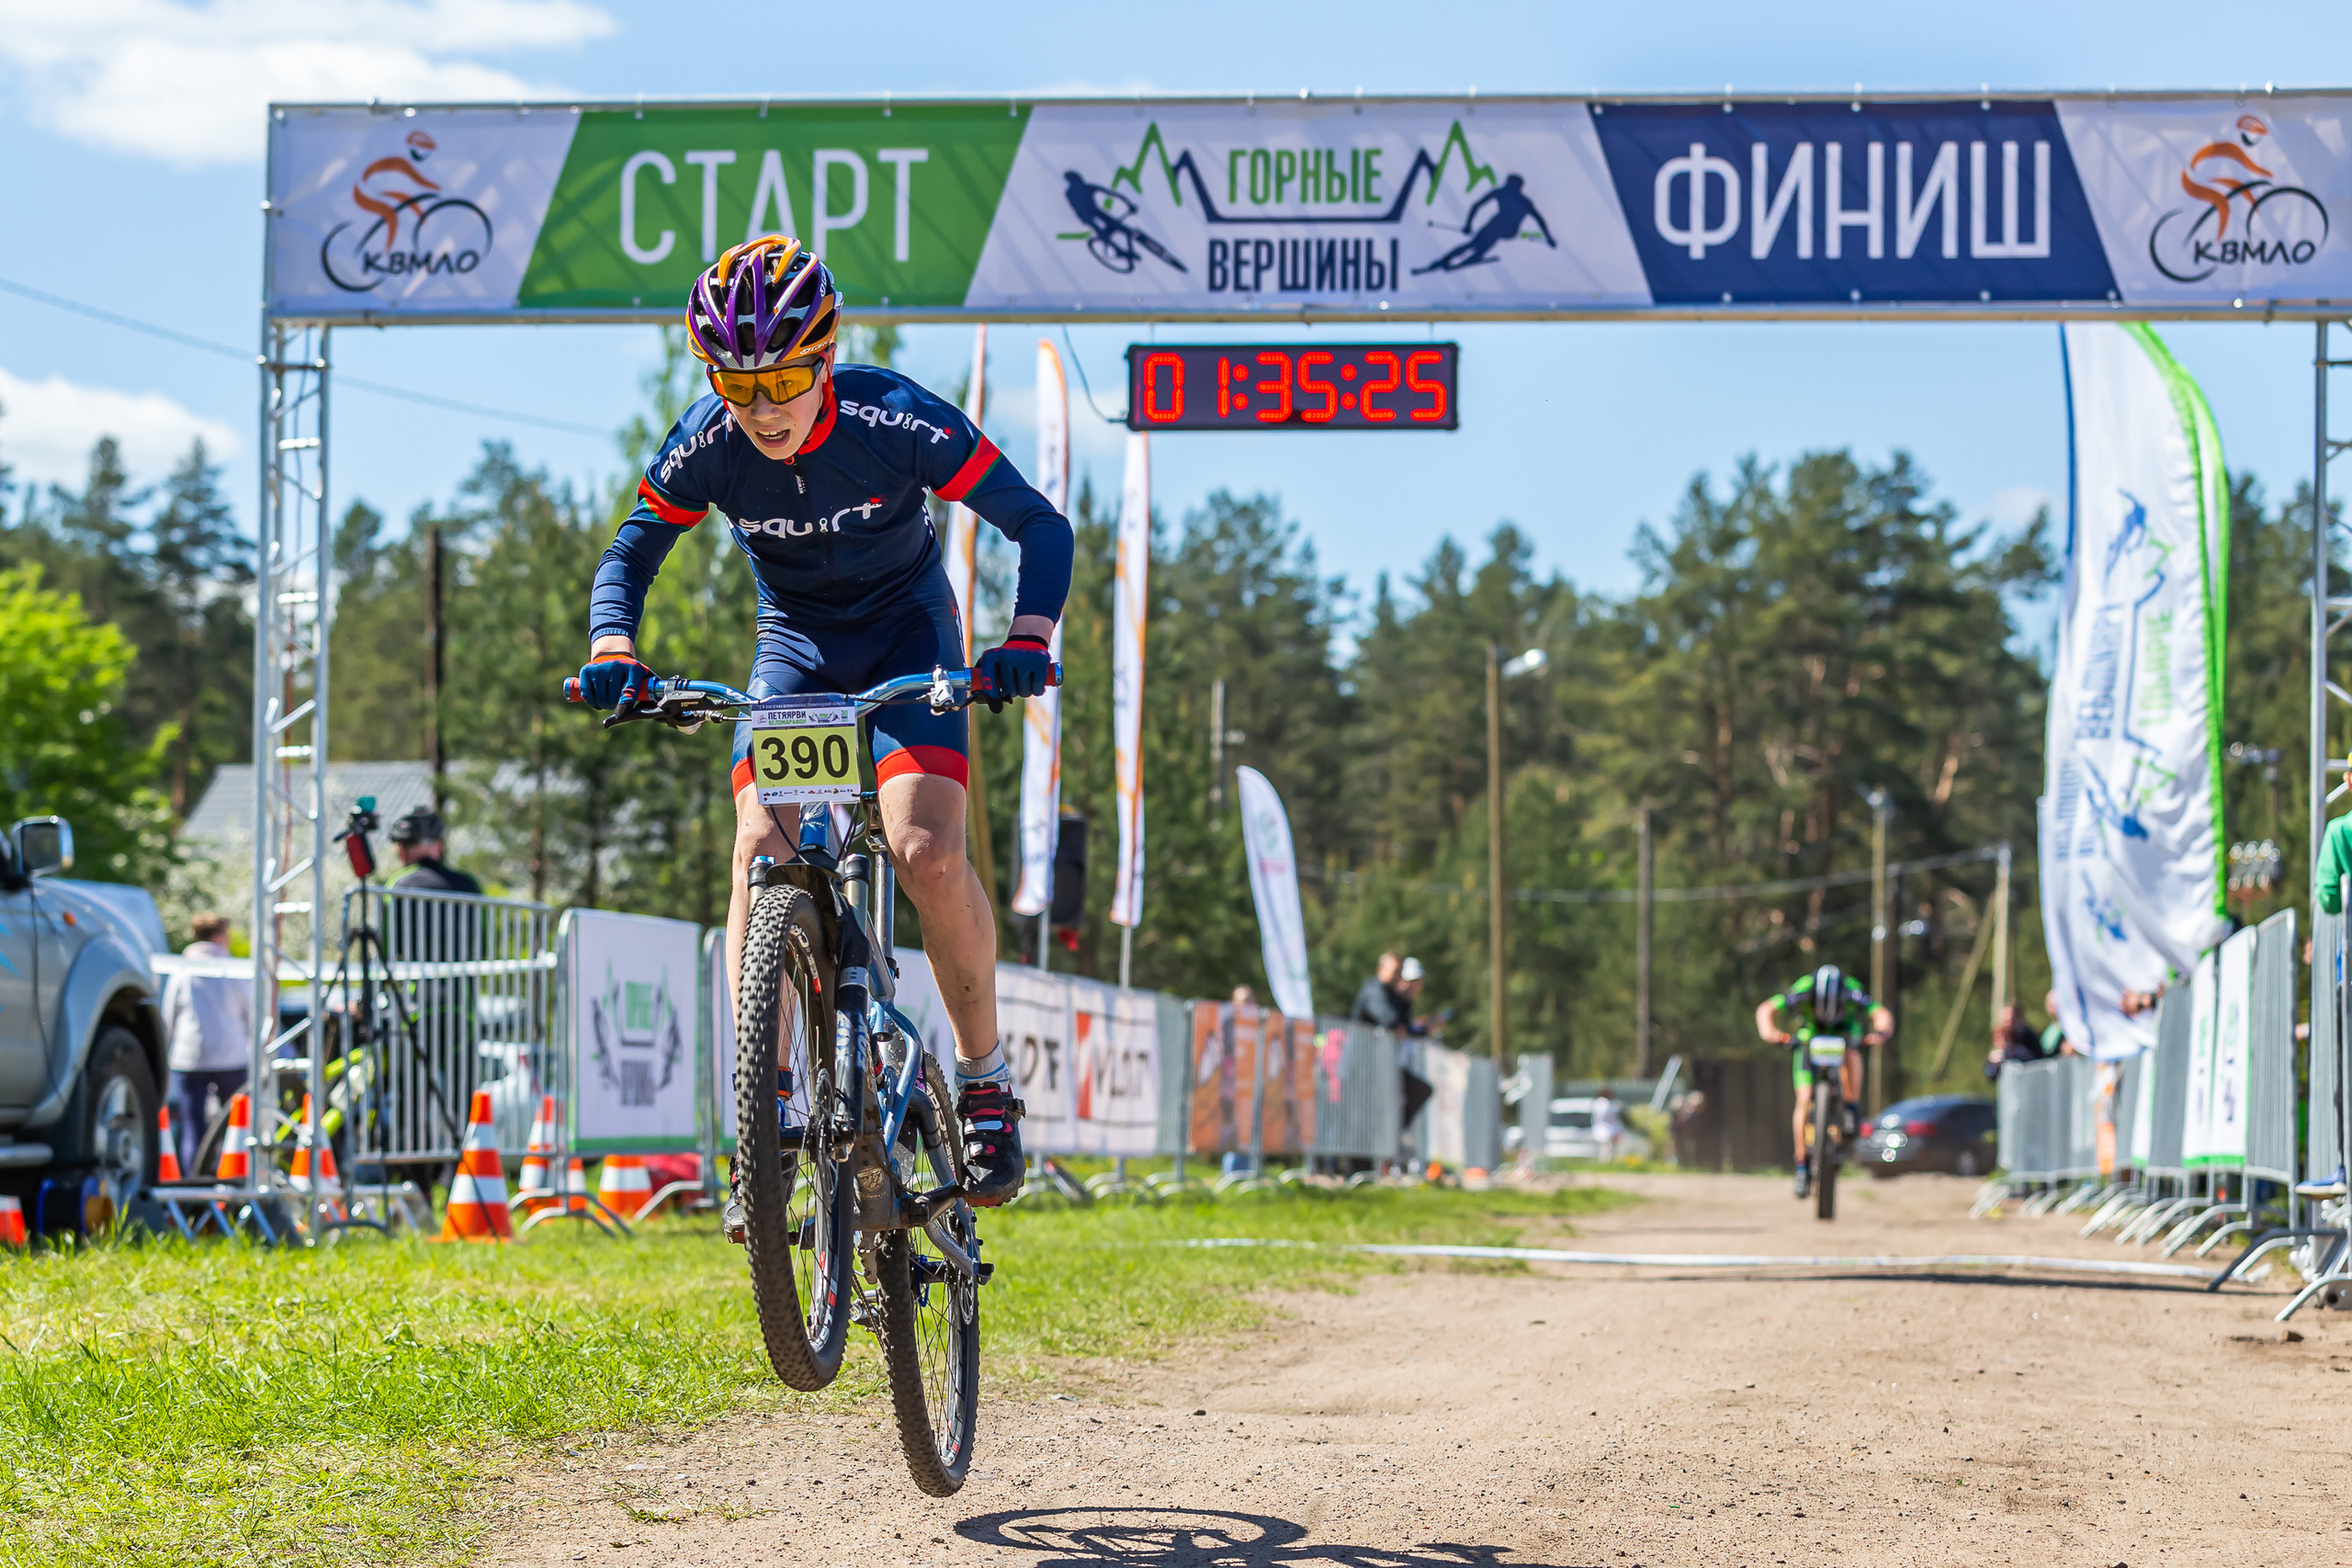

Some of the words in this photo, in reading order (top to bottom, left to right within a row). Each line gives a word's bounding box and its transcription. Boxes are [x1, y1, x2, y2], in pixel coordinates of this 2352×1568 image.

[1228, 149, 1383, 204] ГОРНЫЕ
[620, 148, 929, 265] СТАРТ
[1655, 140, 2052, 261] ФИНИШ
[362, 248, 479, 276] КВМЛО
[1207, 238, 1399, 293] ВЕРШИНЫ
[2193, 238, 2317, 265] КВМЛО
[839, 400, 950, 444] squirt
[660, 412, 736, 484] squirt
[739, 502, 882, 539] squirt
[767, 710, 807, 720] ПЕТЯЯРВИ
[761, 734, 849, 781] 390
